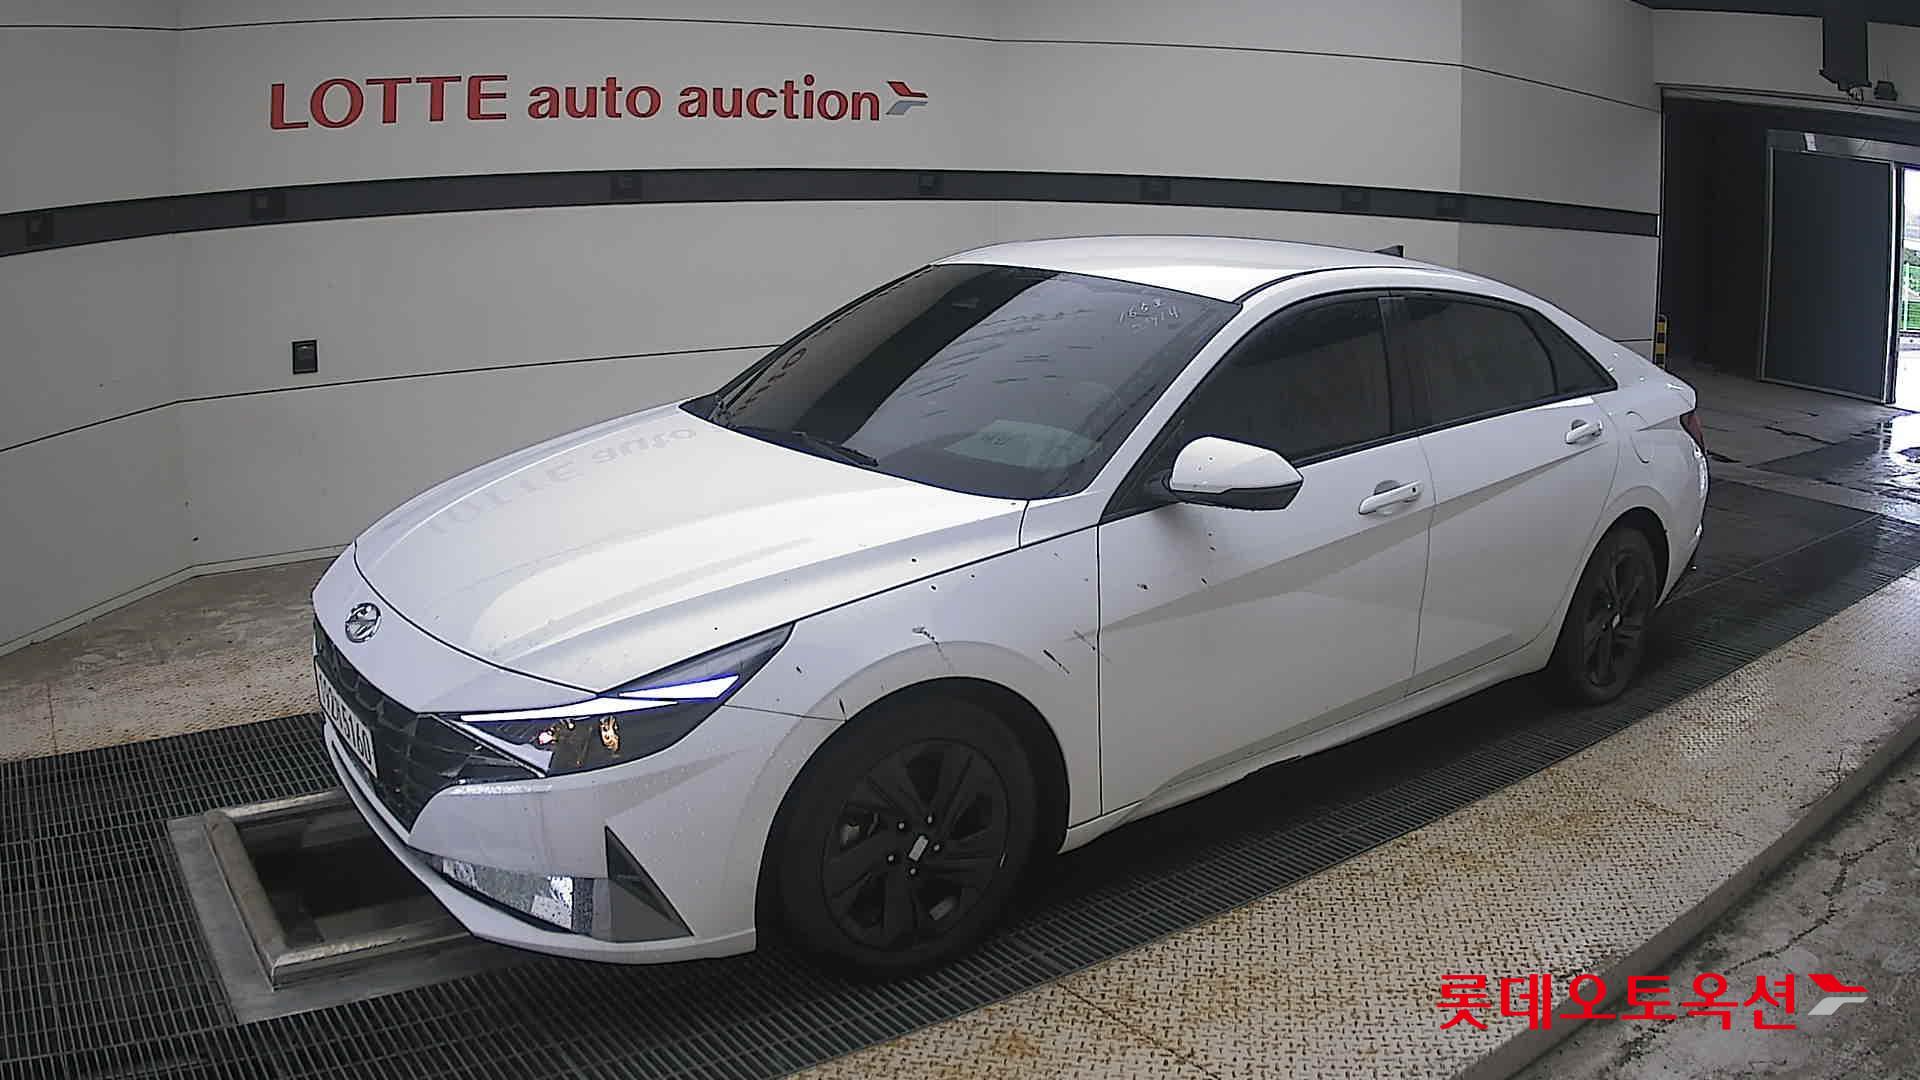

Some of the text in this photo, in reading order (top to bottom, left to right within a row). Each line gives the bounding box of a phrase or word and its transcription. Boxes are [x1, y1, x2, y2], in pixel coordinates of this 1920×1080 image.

[270, 74, 880, 130] LOTTE auto auction
